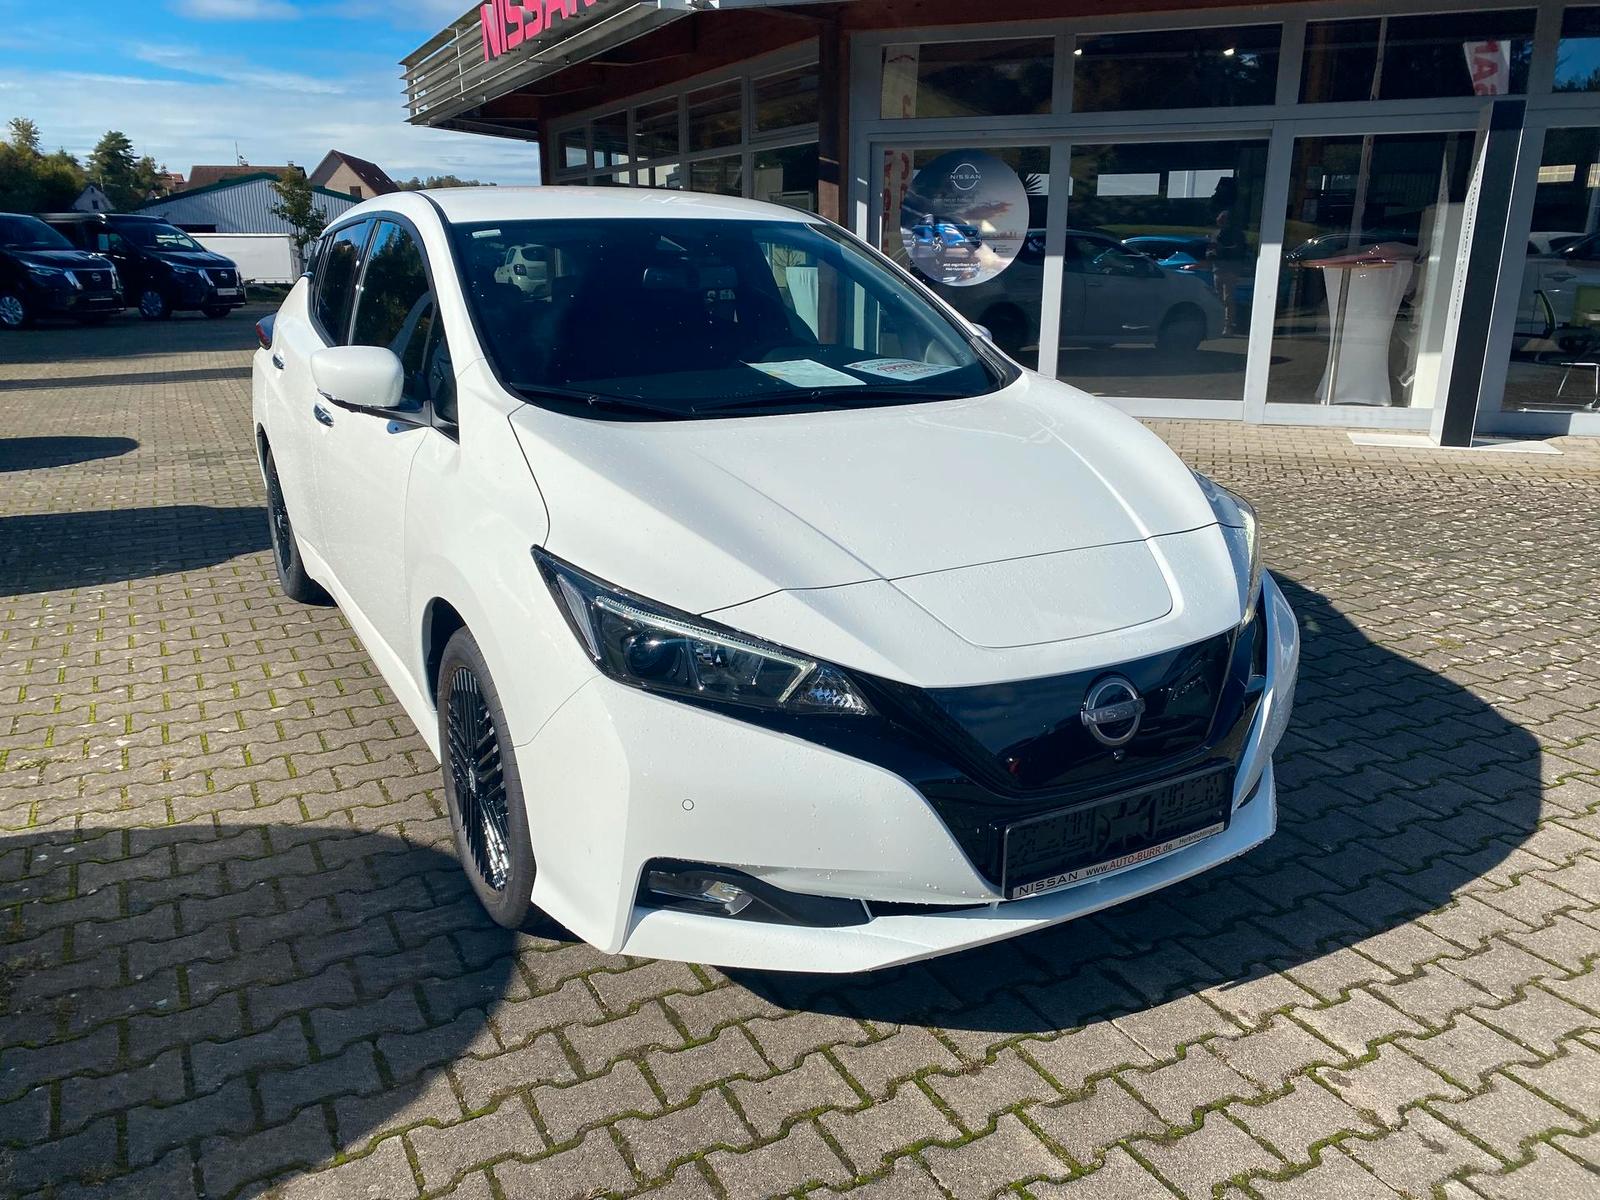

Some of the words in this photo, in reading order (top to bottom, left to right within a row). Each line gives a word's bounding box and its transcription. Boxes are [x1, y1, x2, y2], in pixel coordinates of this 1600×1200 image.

[480, 0, 597, 63] NISSA
[1019, 872, 1078, 895] NISSAN
[1086, 843, 1173, 876] www.AUTO-BURR.de
